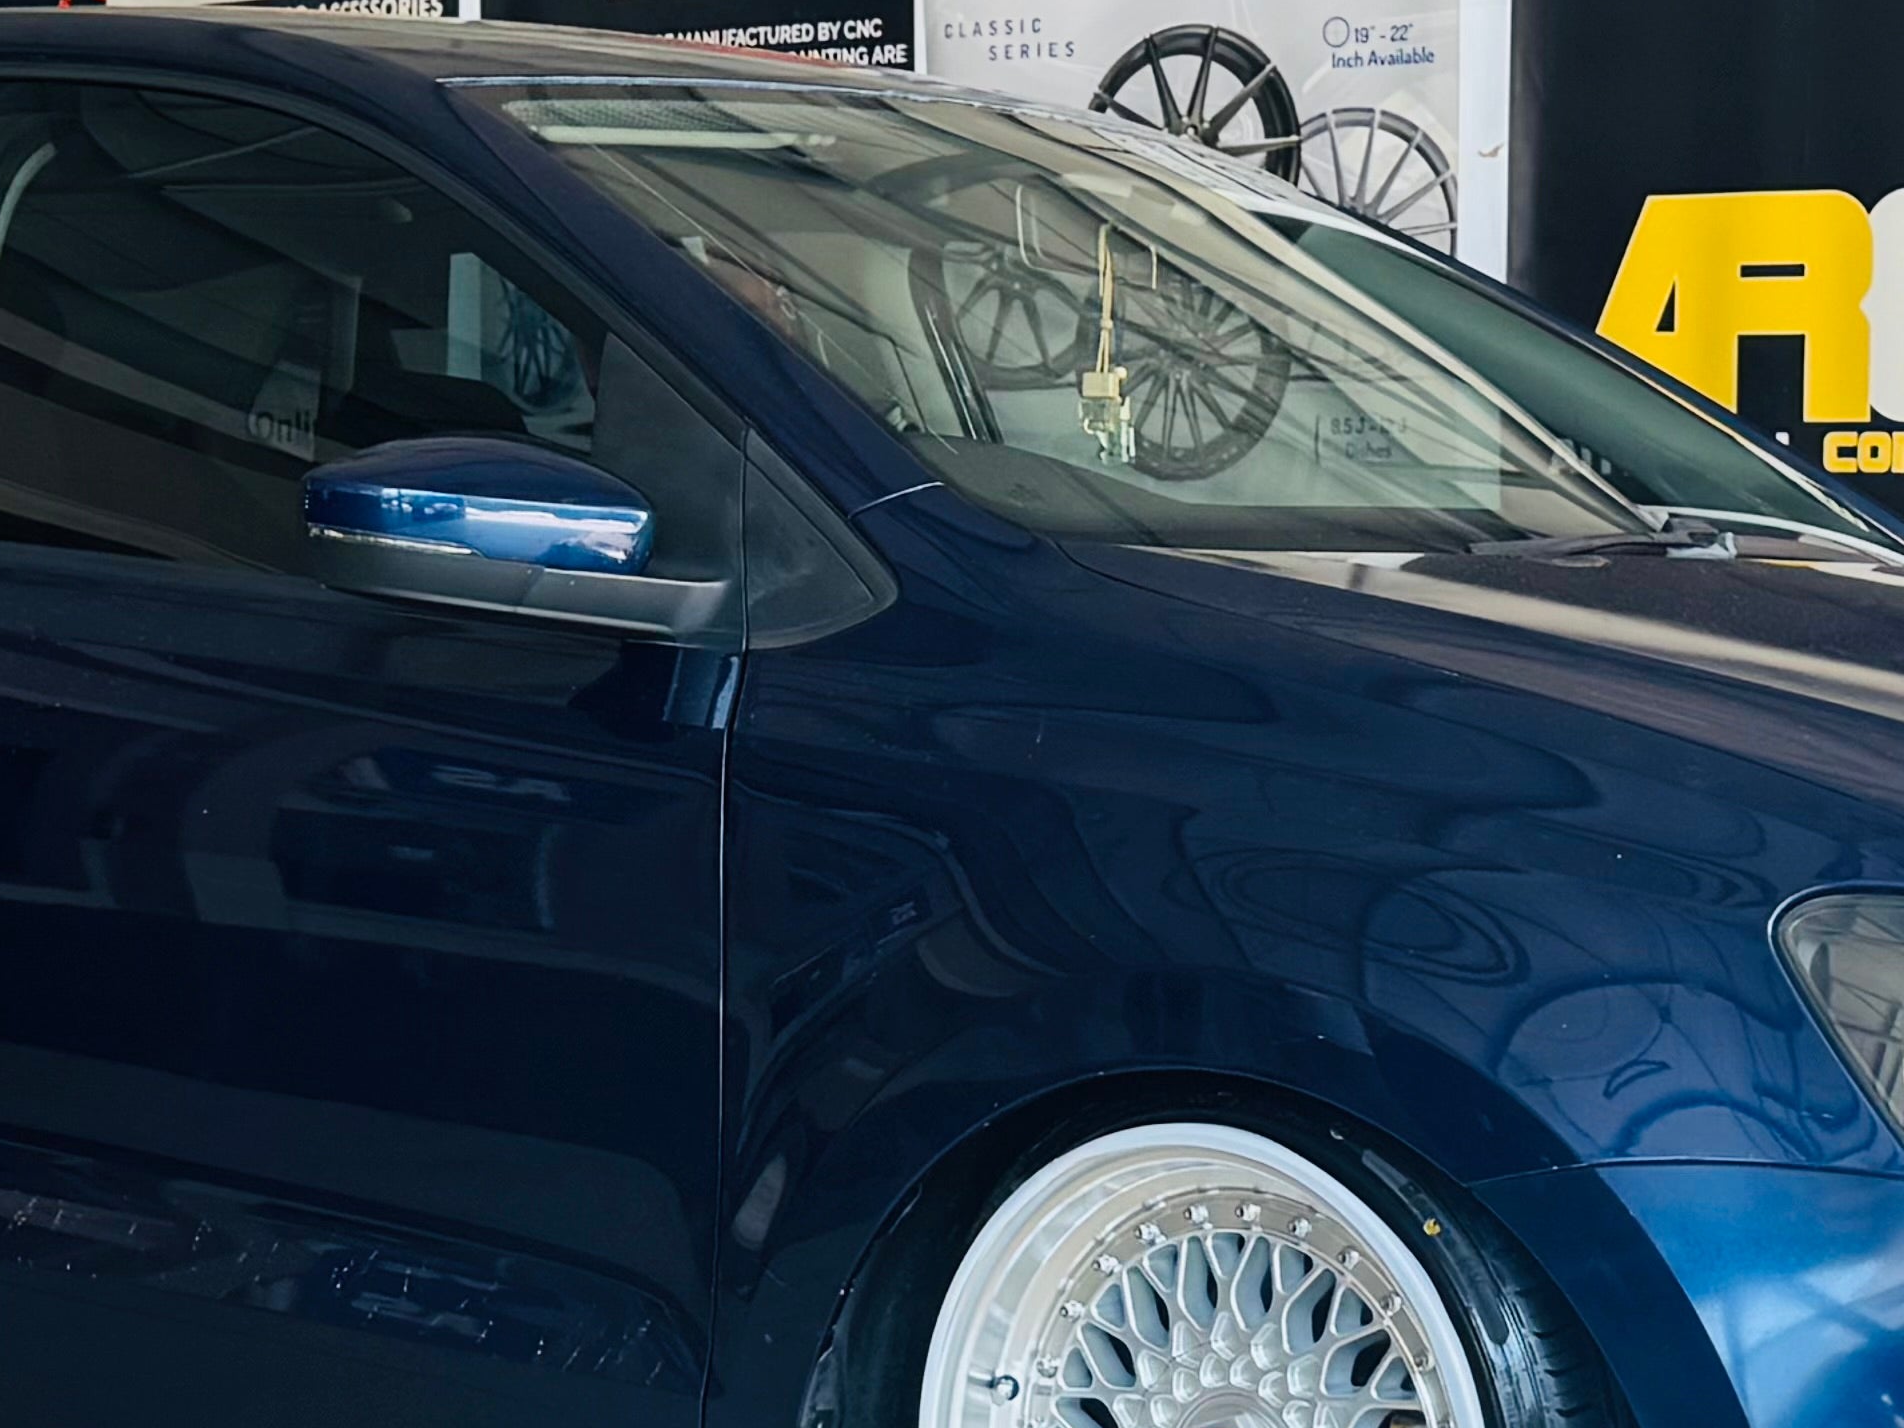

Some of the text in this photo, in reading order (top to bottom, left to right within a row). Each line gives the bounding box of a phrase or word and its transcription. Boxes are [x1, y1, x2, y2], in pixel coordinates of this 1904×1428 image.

[817, 18, 883, 42] BY CNC
[943, 16, 1043, 39] CLASSIC
[872, 44, 908, 64] ARE
[988, 40, 1076, 61] SERIES
[1331, 46, 1434, 68] Inch Available
